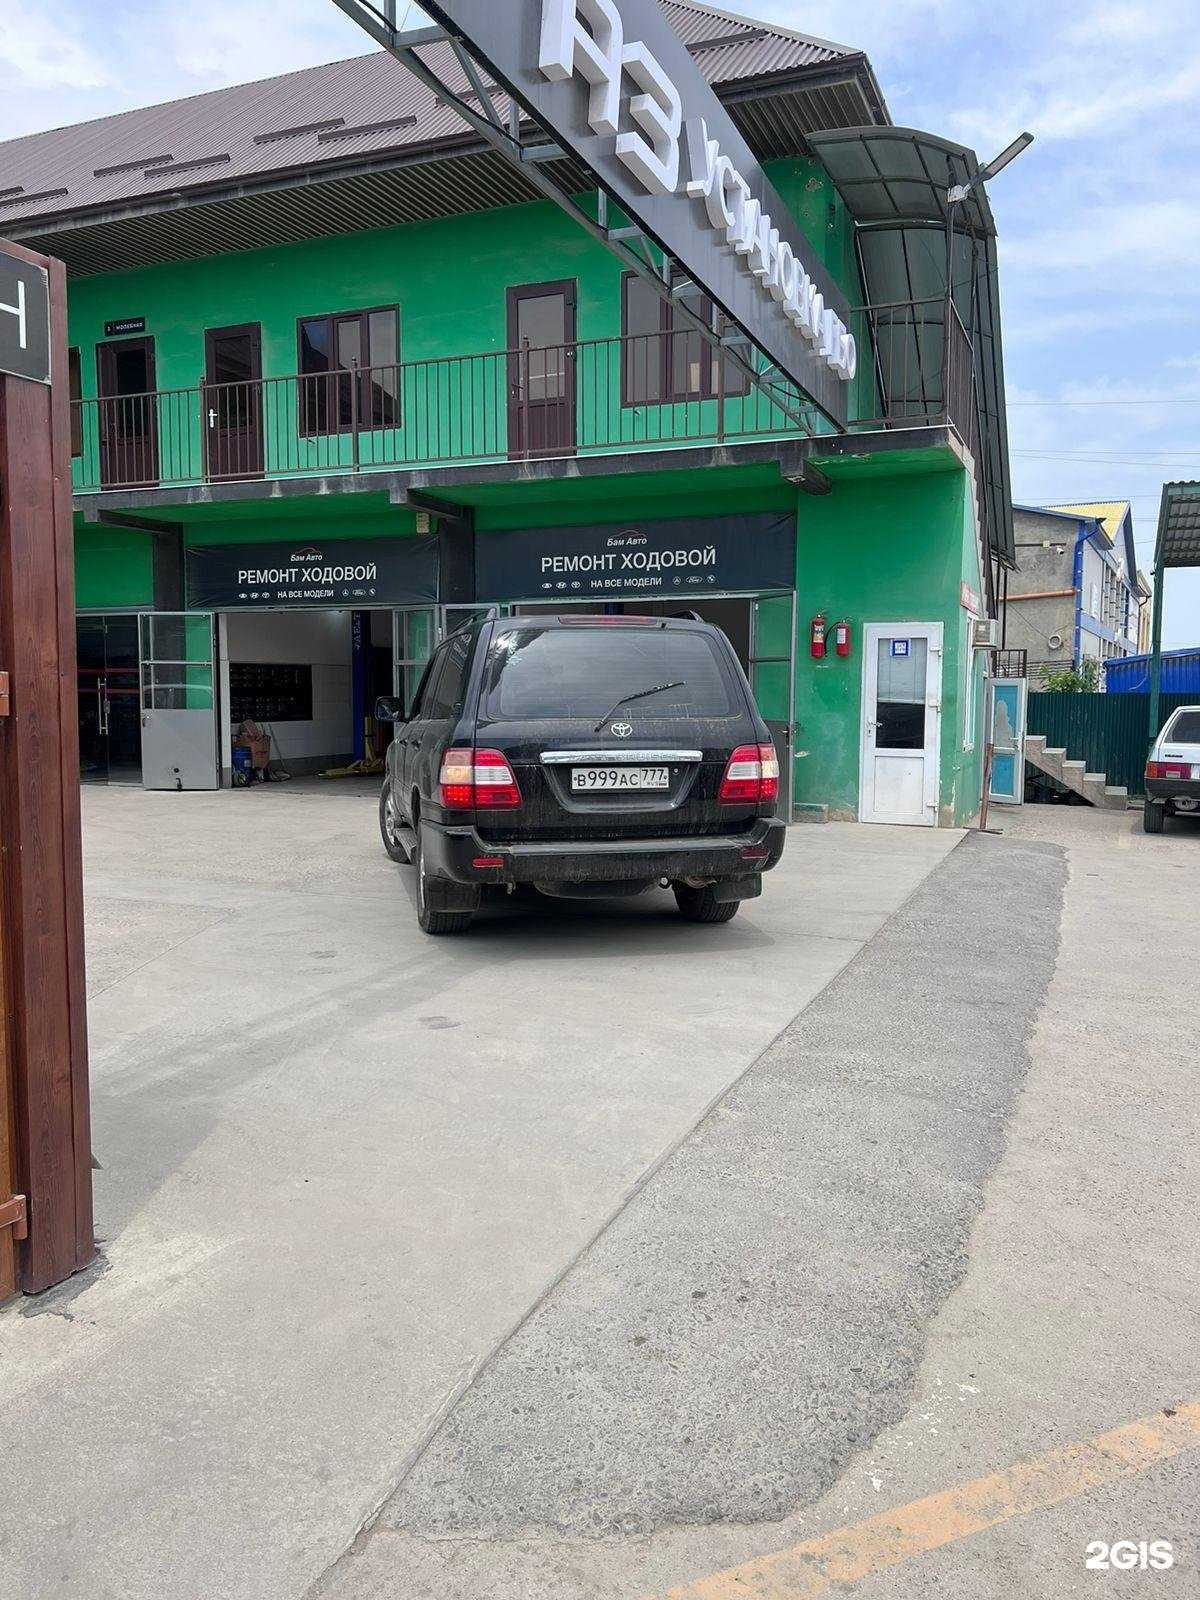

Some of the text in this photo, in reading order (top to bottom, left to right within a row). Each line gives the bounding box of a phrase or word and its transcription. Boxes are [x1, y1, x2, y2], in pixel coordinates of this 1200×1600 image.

[606, 537, 648, 547] Бам Авто
[305, 553, 323, 562] Авто
[541, 545, 717, 573] РЕМОНТ ХОДОВОЙ
[238, 562, 377, 584] РЕМОНТ ХОДОВОЙ
[590, 576, 663, 589] НА ВСЕ МОДЕЛИ
[277, 589, 334, 599] НА ВСЕ МОДЕЛИ
